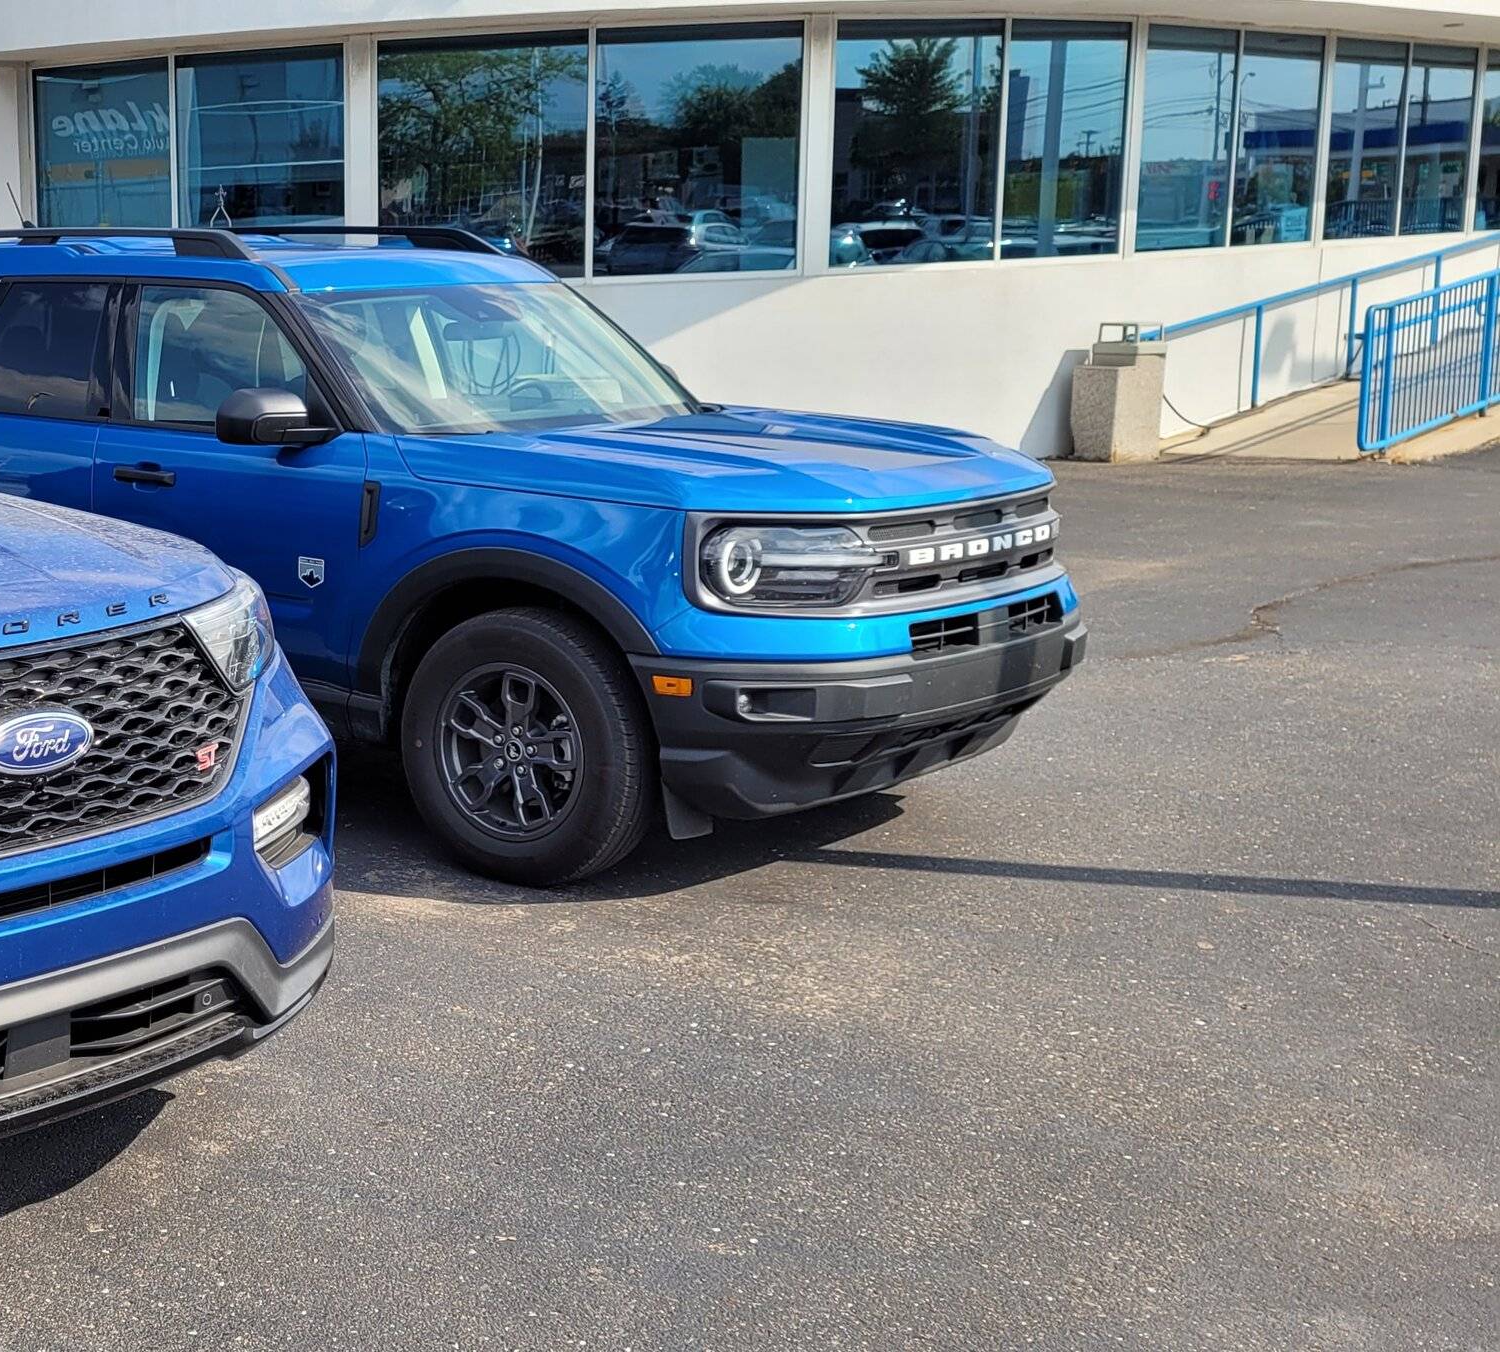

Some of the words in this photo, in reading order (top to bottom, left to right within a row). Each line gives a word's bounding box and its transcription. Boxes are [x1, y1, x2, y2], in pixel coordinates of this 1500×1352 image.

[908, 524, 1051, 566] BRONCO
[12, 723, 71, 763] Ford
[194, 742, 220, 772] ST
